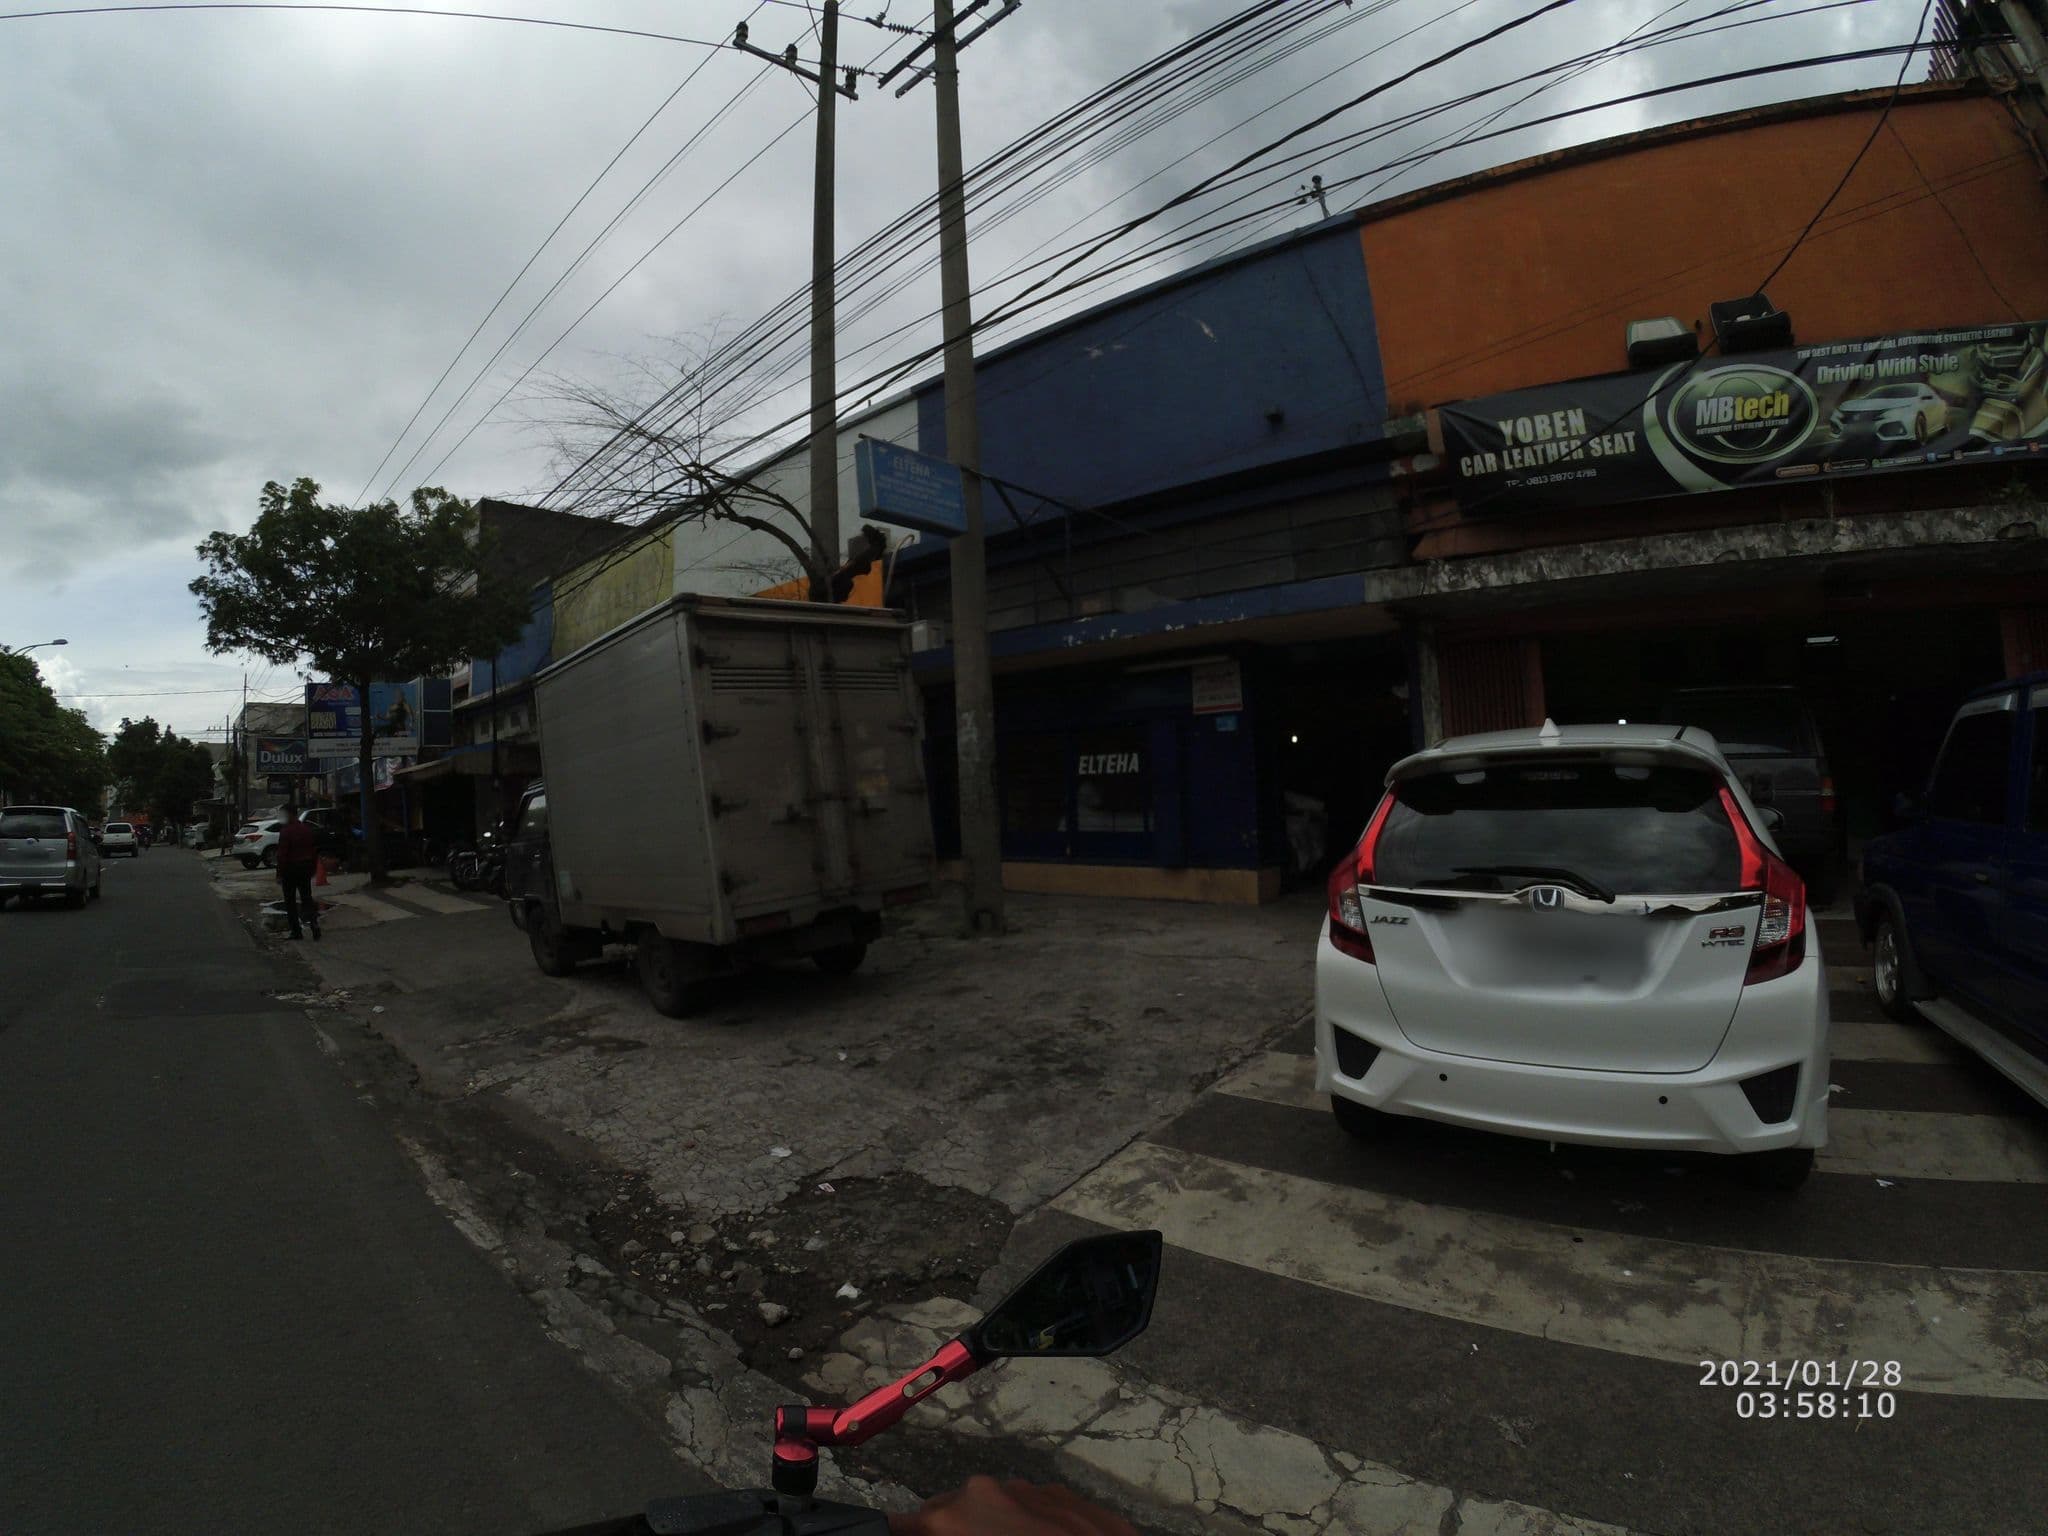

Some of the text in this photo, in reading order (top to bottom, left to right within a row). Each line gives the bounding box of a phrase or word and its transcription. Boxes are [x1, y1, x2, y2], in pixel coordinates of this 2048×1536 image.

[1817, 352, 1960, 385] Driving With Style
[1696, 390, 1790, 426] MBtech
[1497, 407, 1587, 446] YOBEN
[1460, 430, 1636, 477] CAR LEATHER SEAT
[260, 750, 303, 764] Dulux
[1078, 751, 1142, 775] ELTEHA
[1370, 915, 1409, 926] JAZZ
